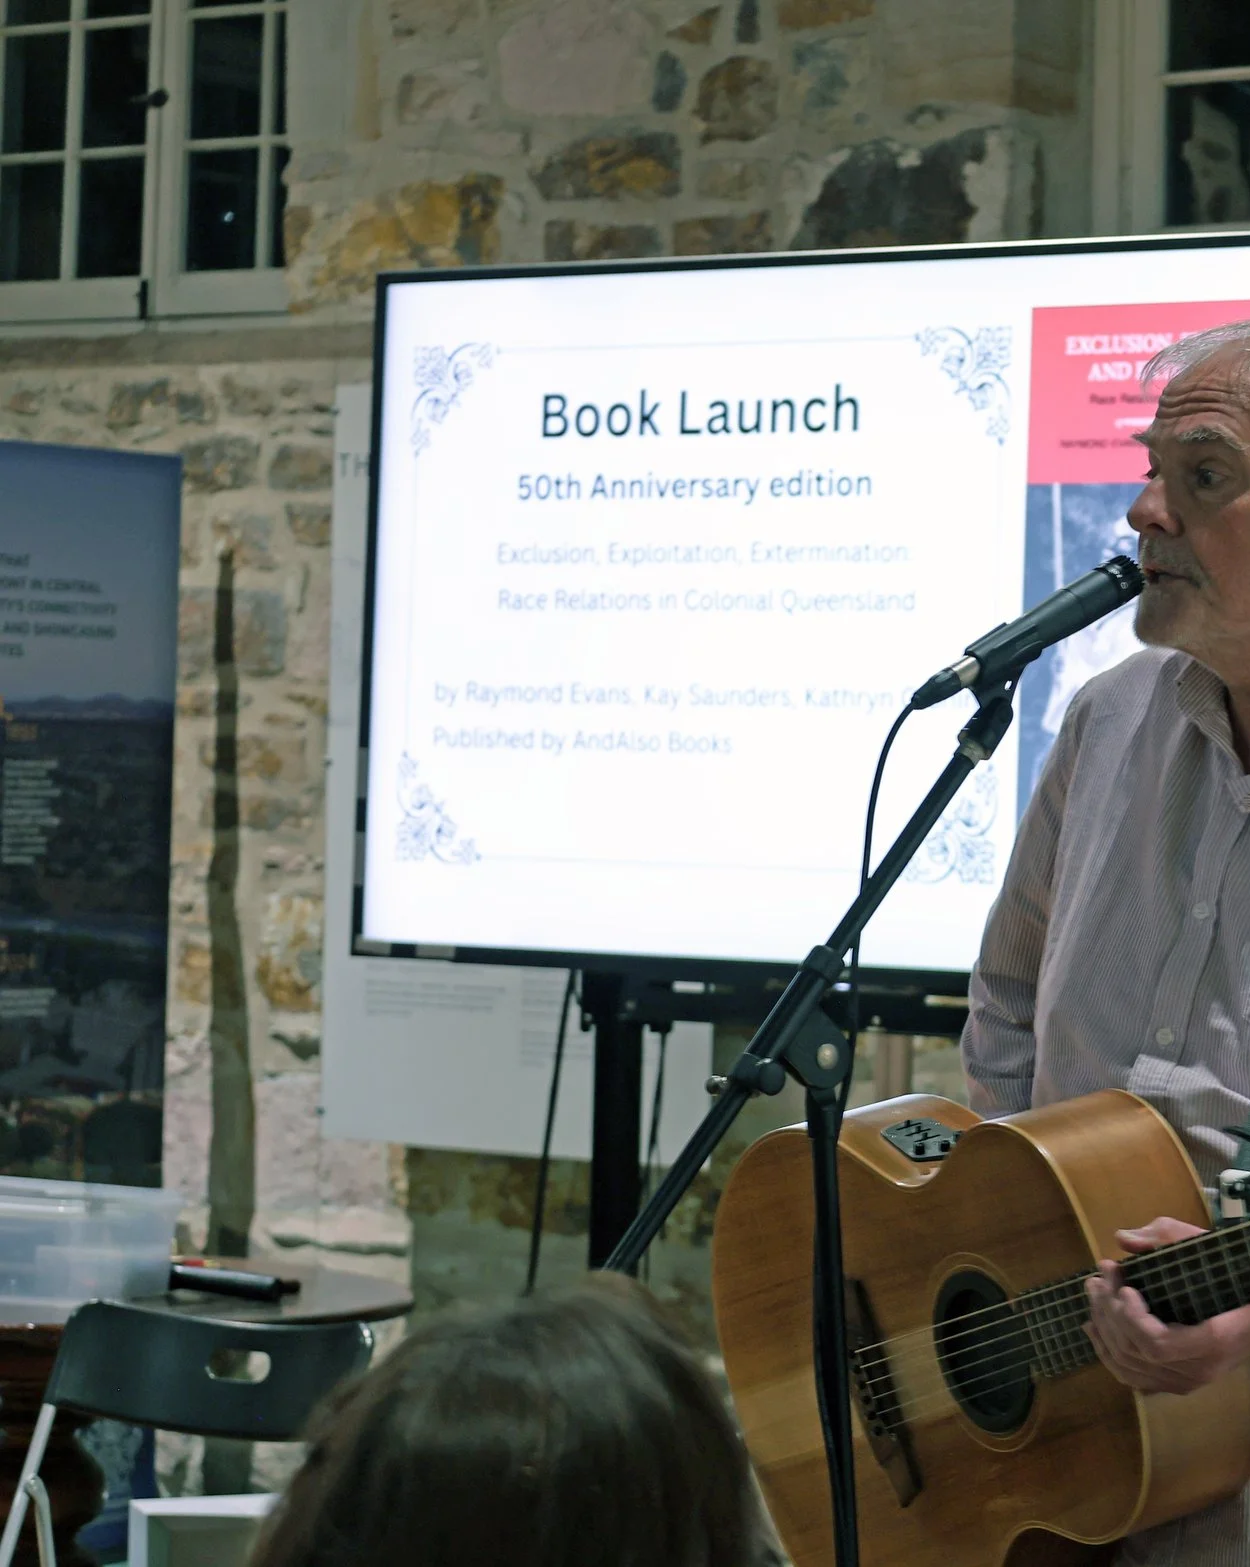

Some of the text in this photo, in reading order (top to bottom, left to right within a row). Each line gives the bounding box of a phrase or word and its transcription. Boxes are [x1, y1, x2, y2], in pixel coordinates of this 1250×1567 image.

[1088, 361, 1133, 382] AND
[542, 384, 860, 438] Book Launch
[517, 470, 872, 506] 50th Anniversary edition
[496, 541, 601, 567] Exclusion,
[607, 541, 744, 569] Exploitation,
[497, 587, 916, 616] Race Relations in Colonial Queensland
[34, 622, 117, 640] SHOWCASING
[434, 683, 459, 708] by
[465, 681, 564, 710] Raymond
[642, 684, 681, 711] Kay
[803, 687, 893, 714] Kathryn
[433, 726, 733, 756] Published by AndAlso Books
